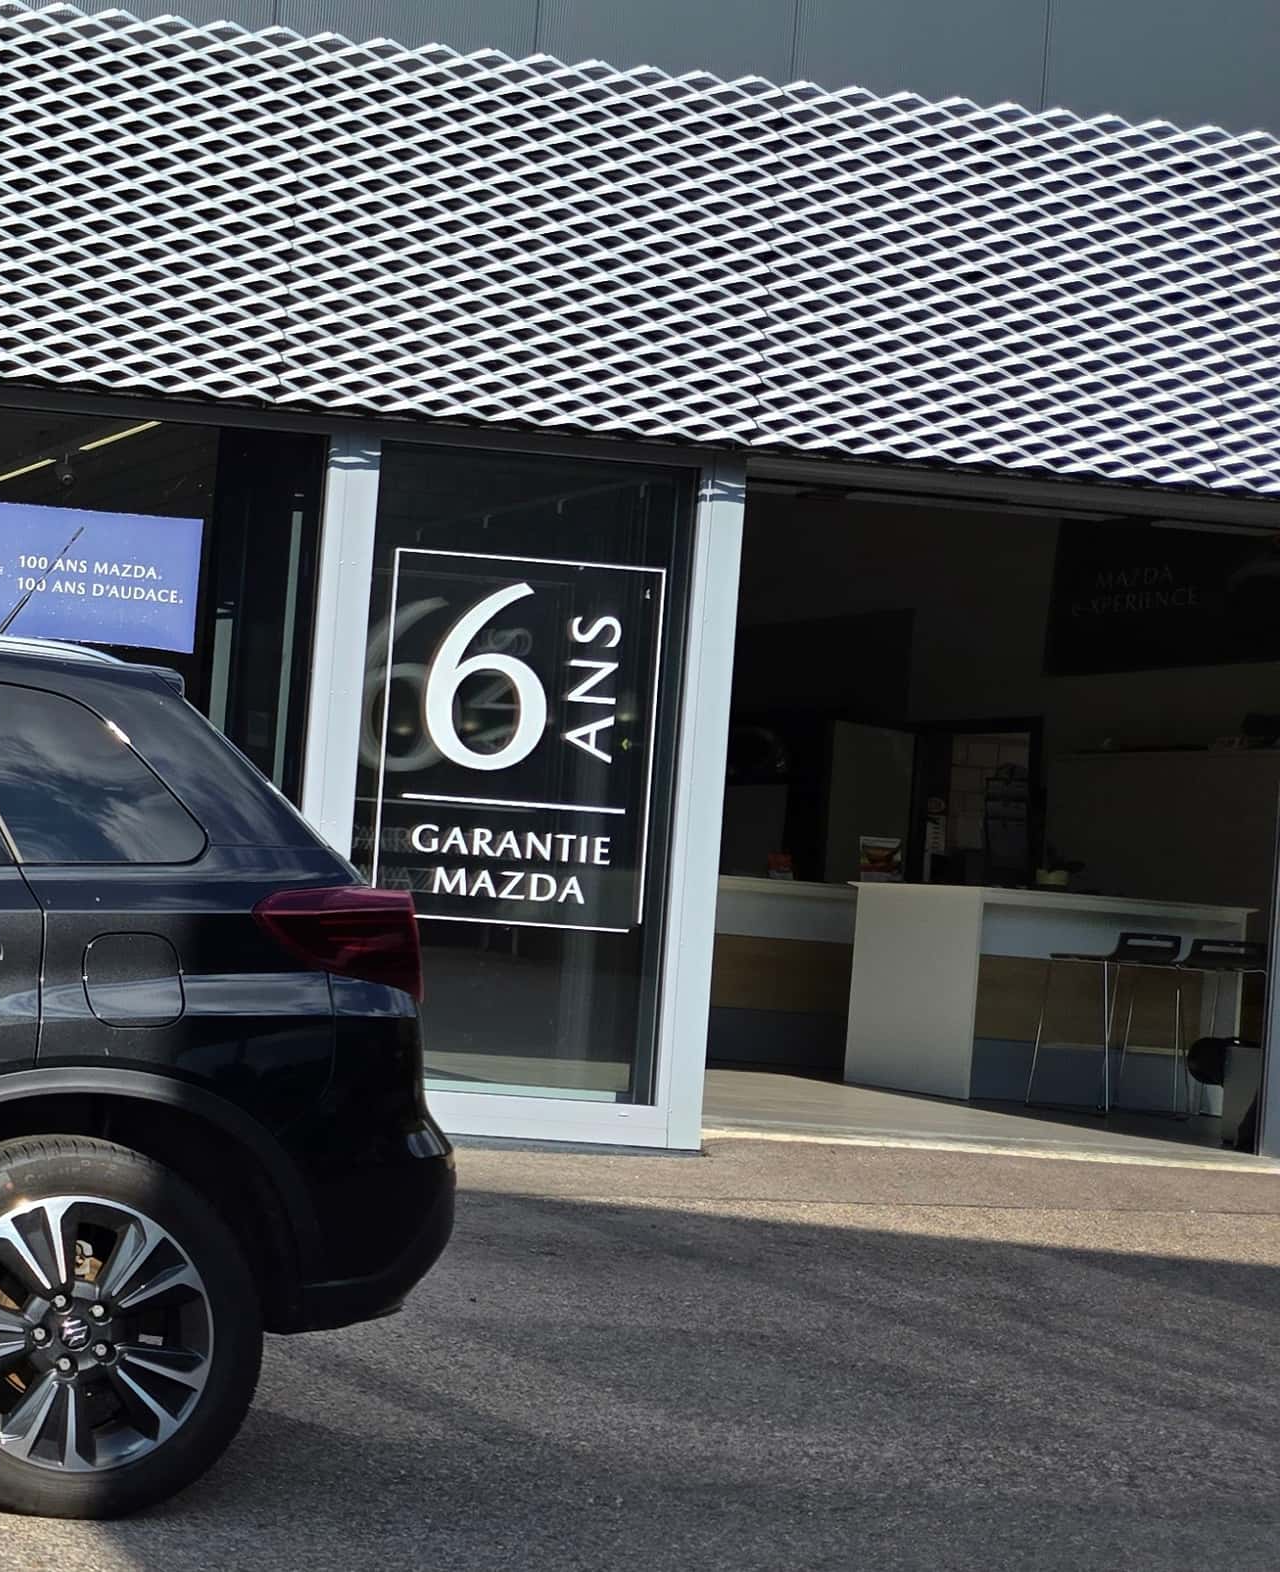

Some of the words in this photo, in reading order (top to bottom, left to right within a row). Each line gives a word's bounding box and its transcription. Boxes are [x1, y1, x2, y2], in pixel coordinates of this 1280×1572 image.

[18, 555, 48, 570] 100
[51, 558, 88, 574] ANS
[92, 561, 163, 580] MAZDA.
[17, 577, 46, 592] 100
[51, 580, 86, 595] ANS
[92, 583, 184, 604] D'AUDACE.
[424, 581, 548, 771] 6
[562, 615, 623, 765] ANS
[410, 823, 612, 866] GARANTIE
[431, 866, 586, 905] MAZDA
